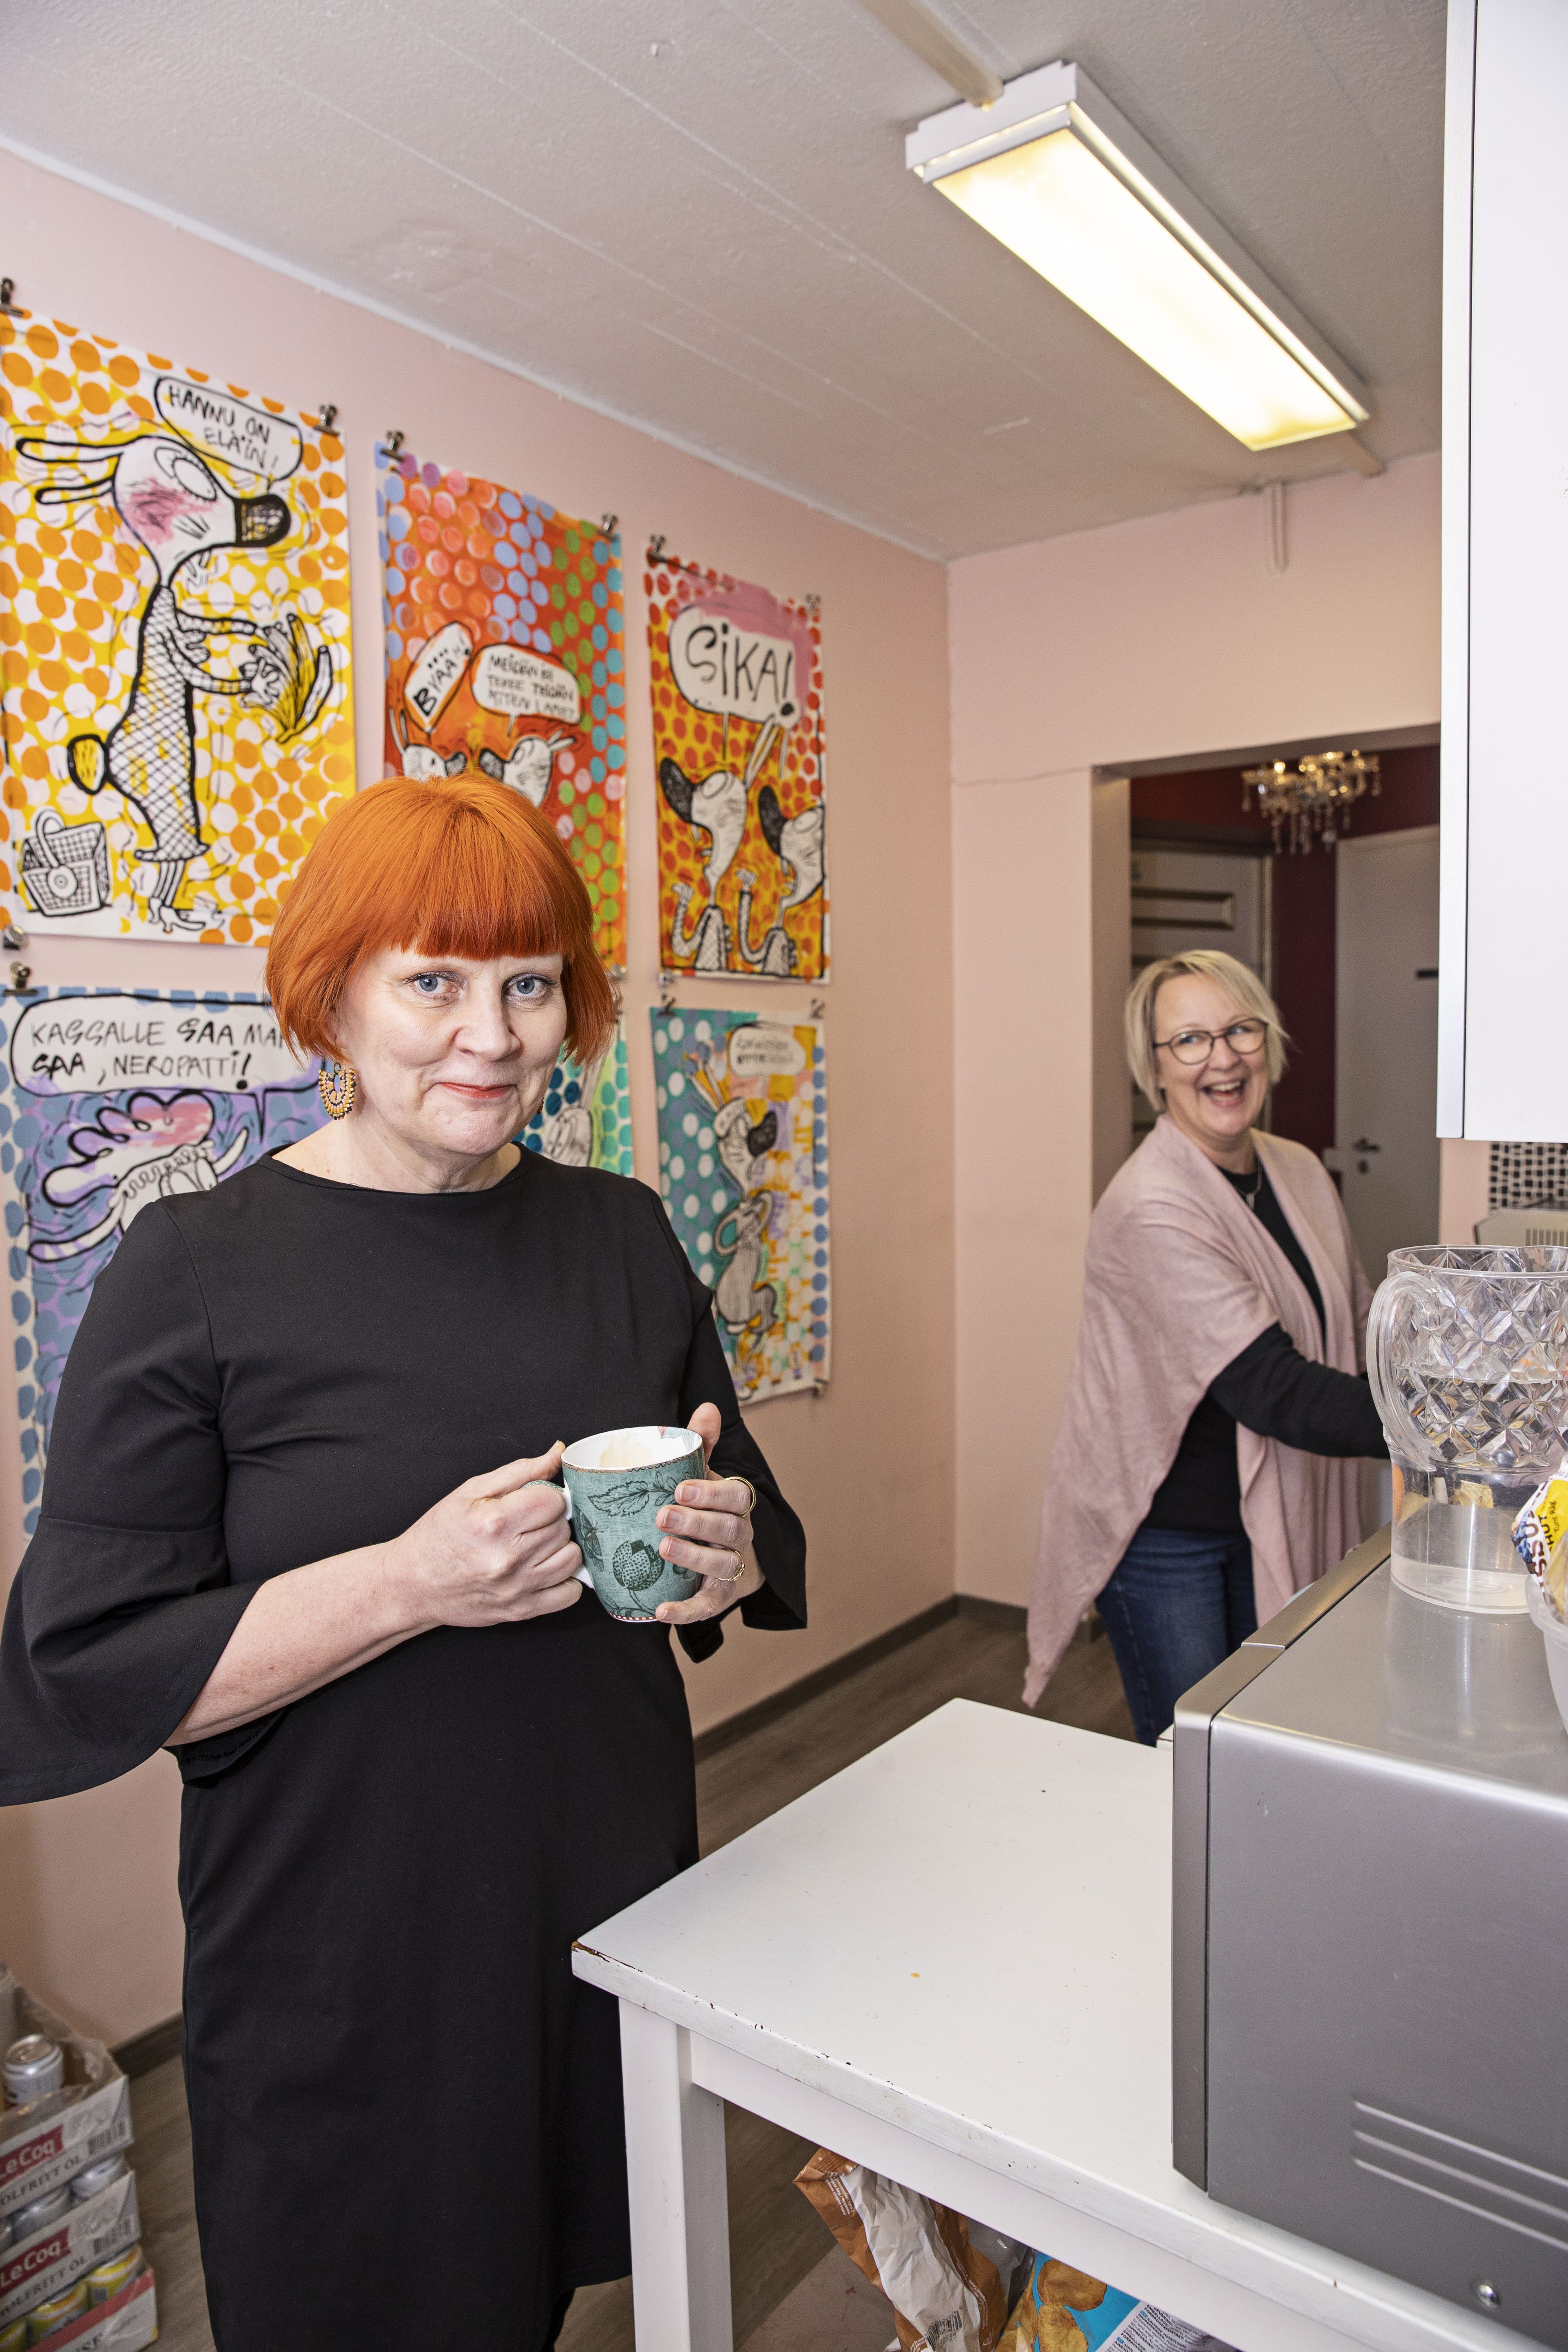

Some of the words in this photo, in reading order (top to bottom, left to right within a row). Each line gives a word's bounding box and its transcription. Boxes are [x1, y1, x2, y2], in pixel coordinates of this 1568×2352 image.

[169, 386, 235, 427] HANNU
[245, 415, 270, 445] ON
[243, 1023, 283, 1049] MA
[1538, 1514, 1554, 1553] HUT
